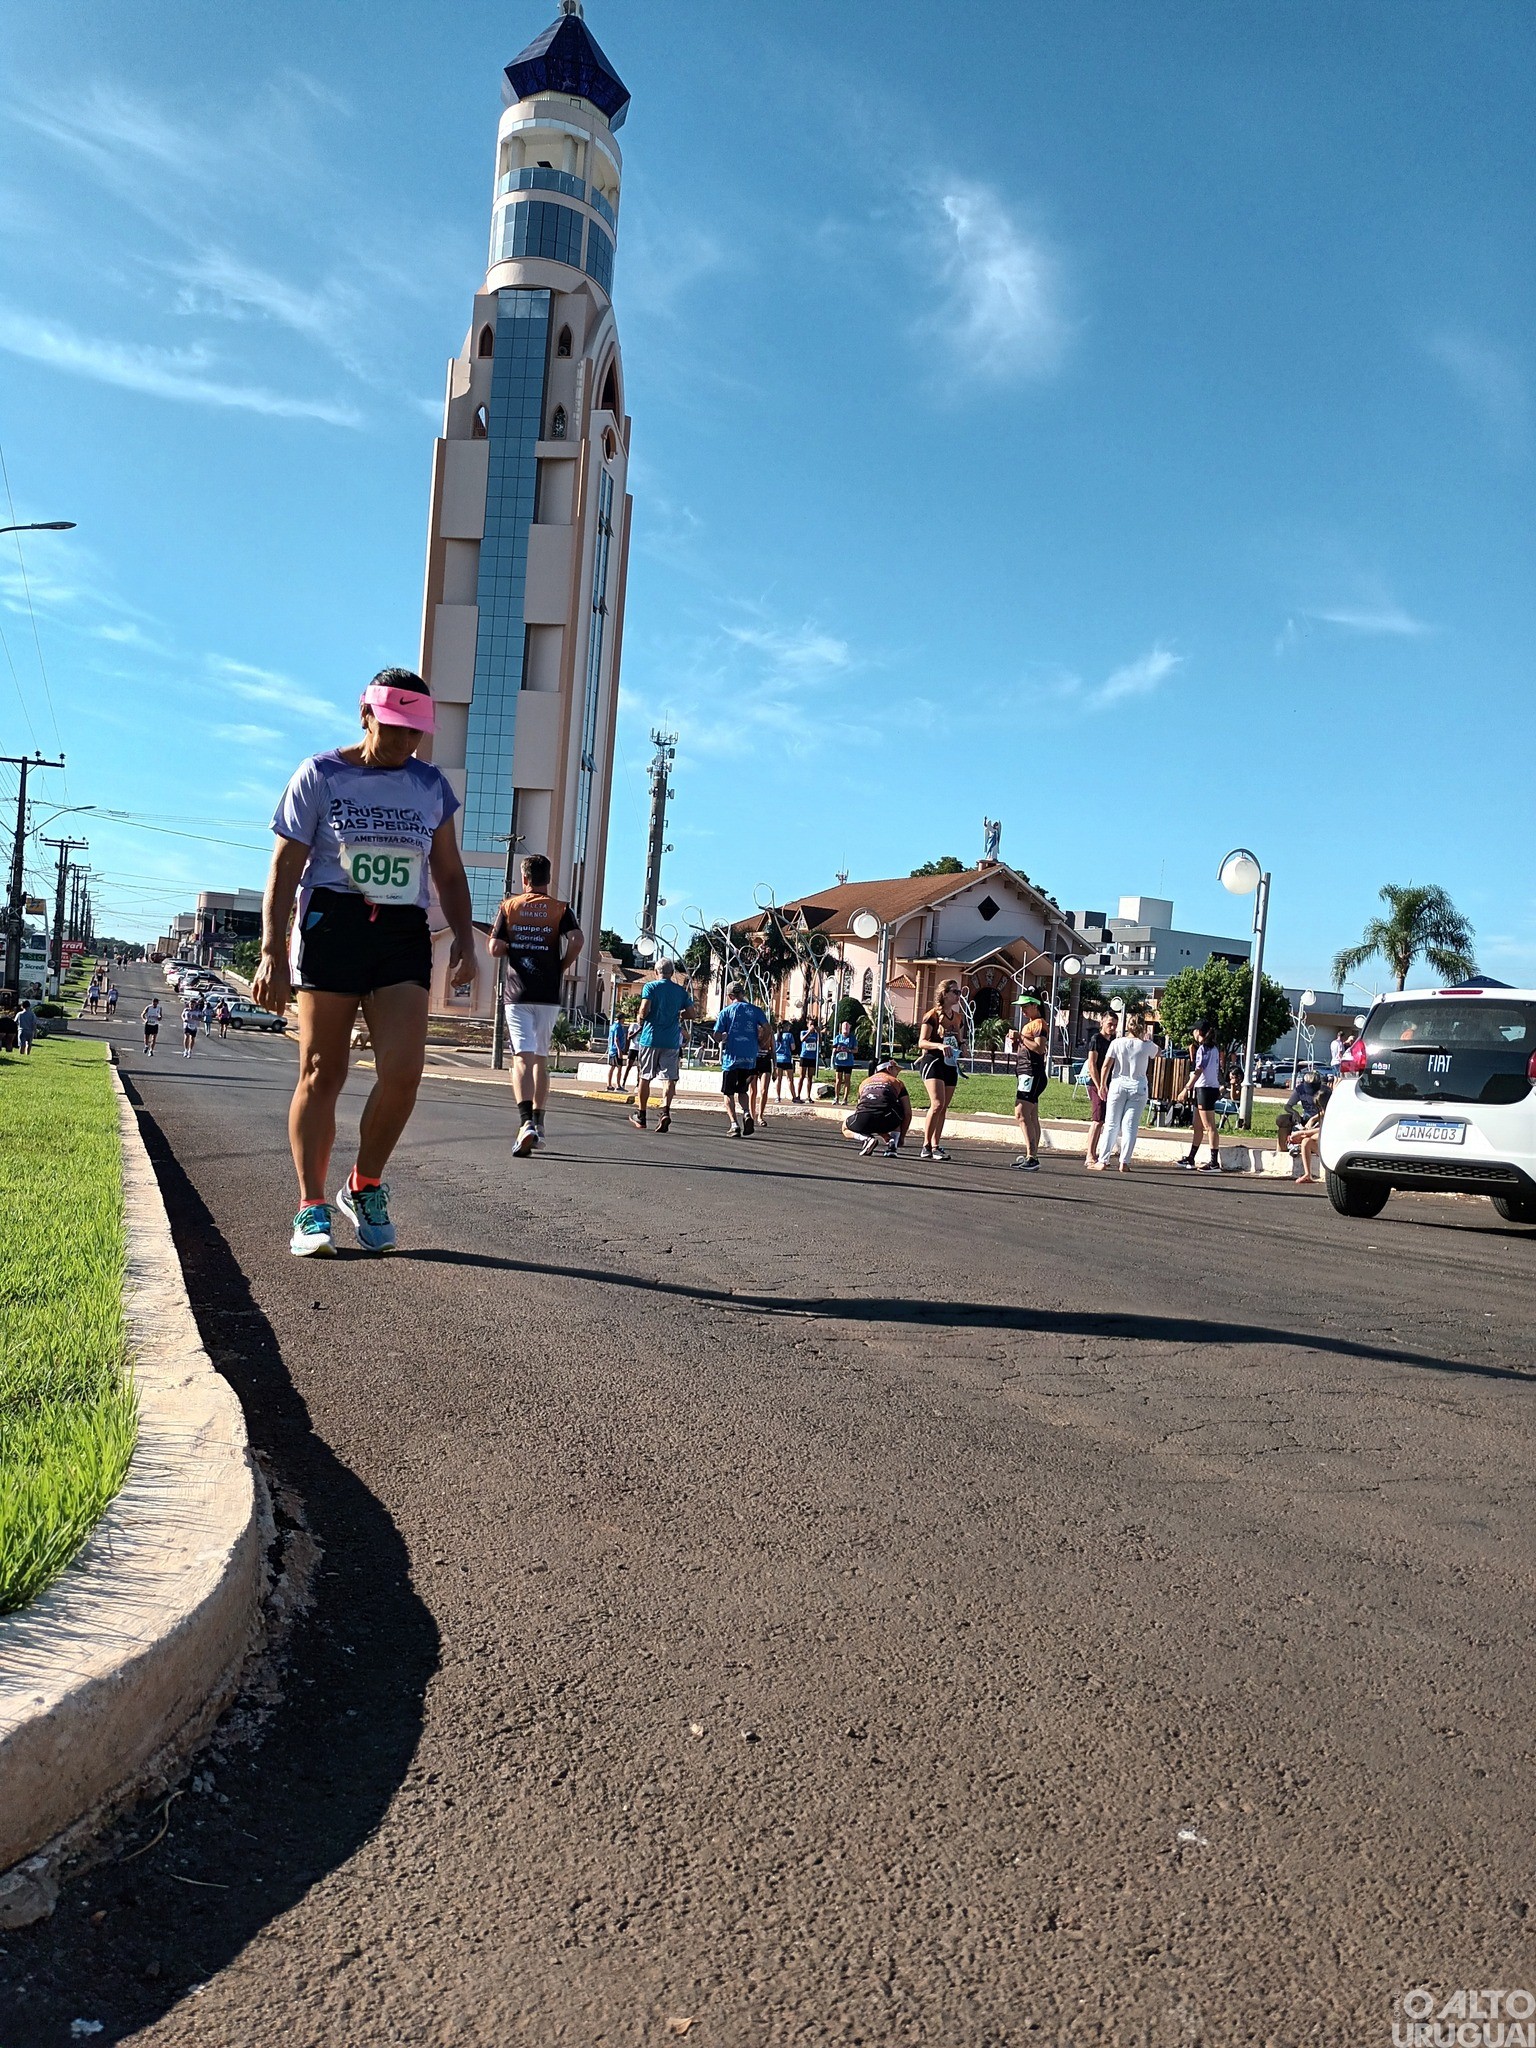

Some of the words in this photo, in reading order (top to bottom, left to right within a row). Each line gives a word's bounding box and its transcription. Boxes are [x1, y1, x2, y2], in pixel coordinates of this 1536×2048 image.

[347, 805, 424, 823] RÚSTICA
[332, 819, 368, 831] DAS
[373, 820, 434, 838] PEDRAS
[352, 853, 411, 888] 695
[1428, 1054, 1453, 1073] FIAT
